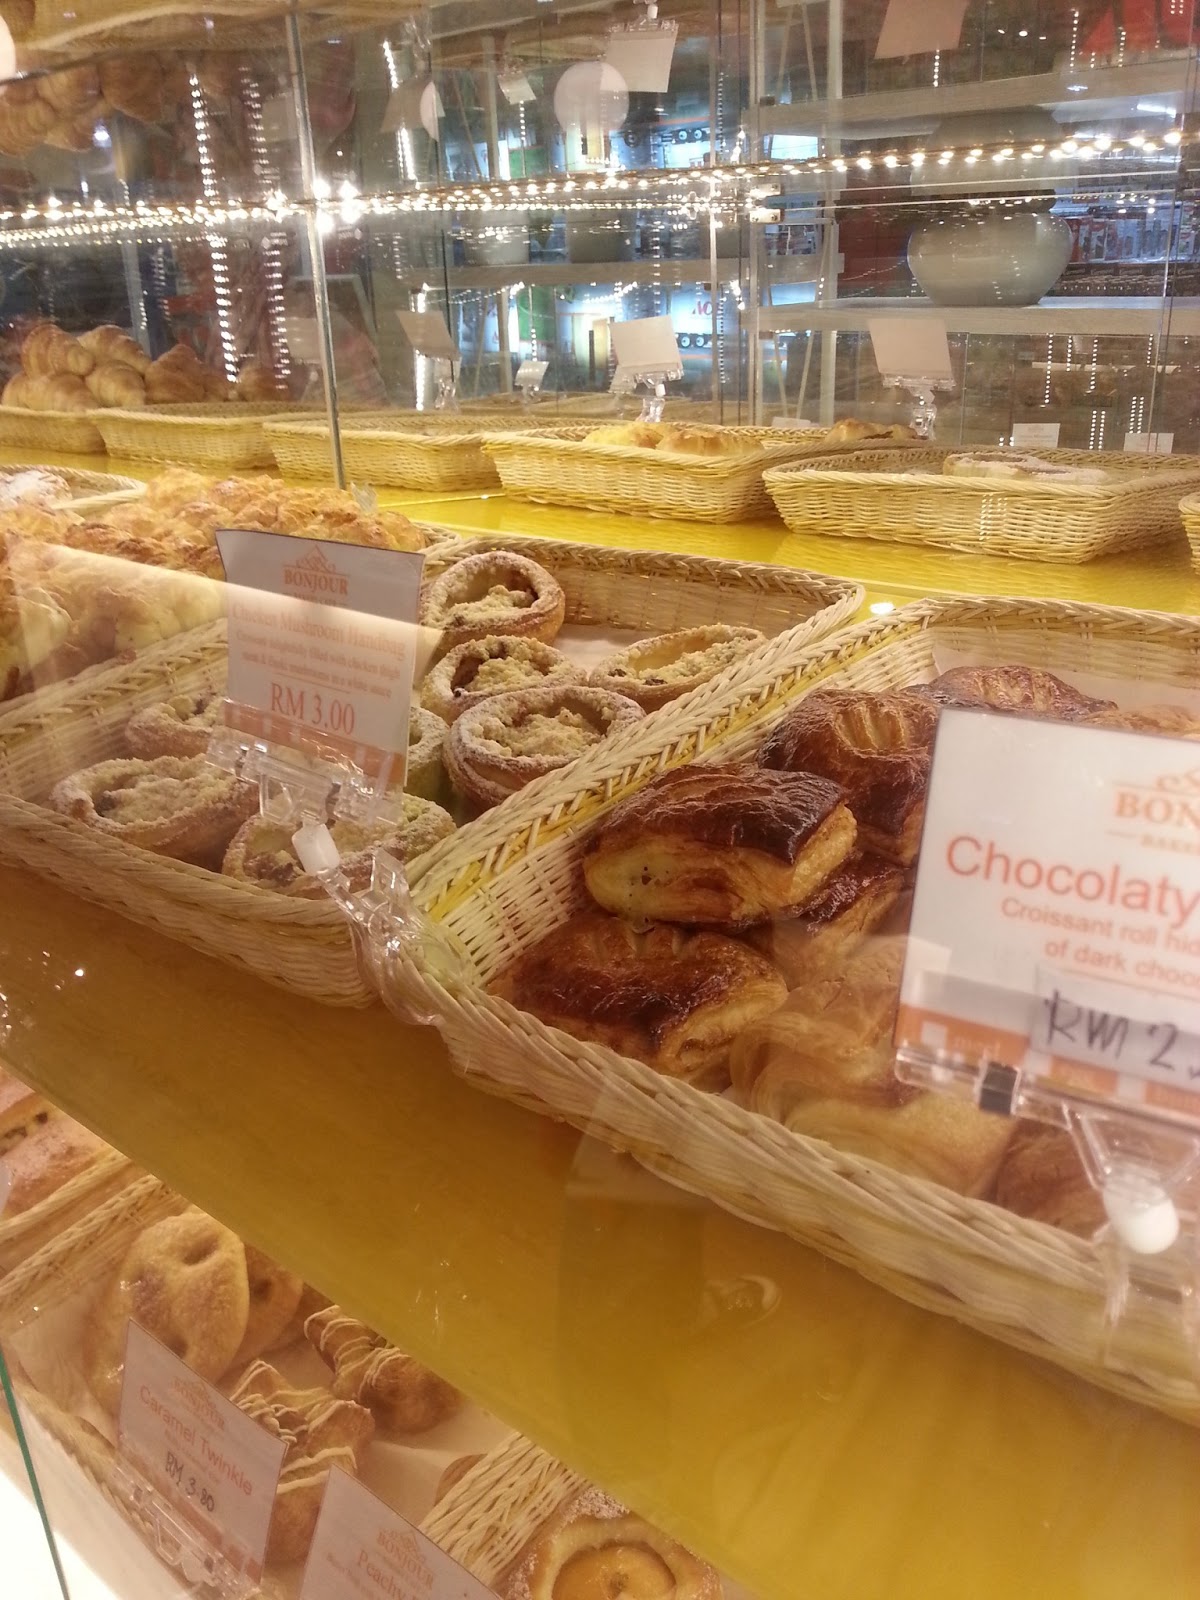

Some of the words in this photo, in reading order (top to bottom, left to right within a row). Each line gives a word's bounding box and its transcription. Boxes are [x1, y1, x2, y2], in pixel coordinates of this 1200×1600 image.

[283, 568, 348, 595] BONJOUR
[280, 610, 344, 645] Mushroom
[348, 626, 405, 661] Handbag
[270, 682, 304, 721] RM
[311, 694, 355, 735] 3.00
[945, 834, 1200, 931] Chocolaty
[1001, 896, 1113, 939] Croissant
[1119, 921, 1157, 945] roll
[1044, 937, 1067, 958] of
[1074, 941, 1128, 972] dark
[1044, 989, 1130, 1059] RM
[139, 1384, 197, 1447] Caramel
[200, 1436, 253, 1495] Twinkle
[164, 1450, 185, 1487] RM
[376, 1530, 434, 1592] BONJOUR
